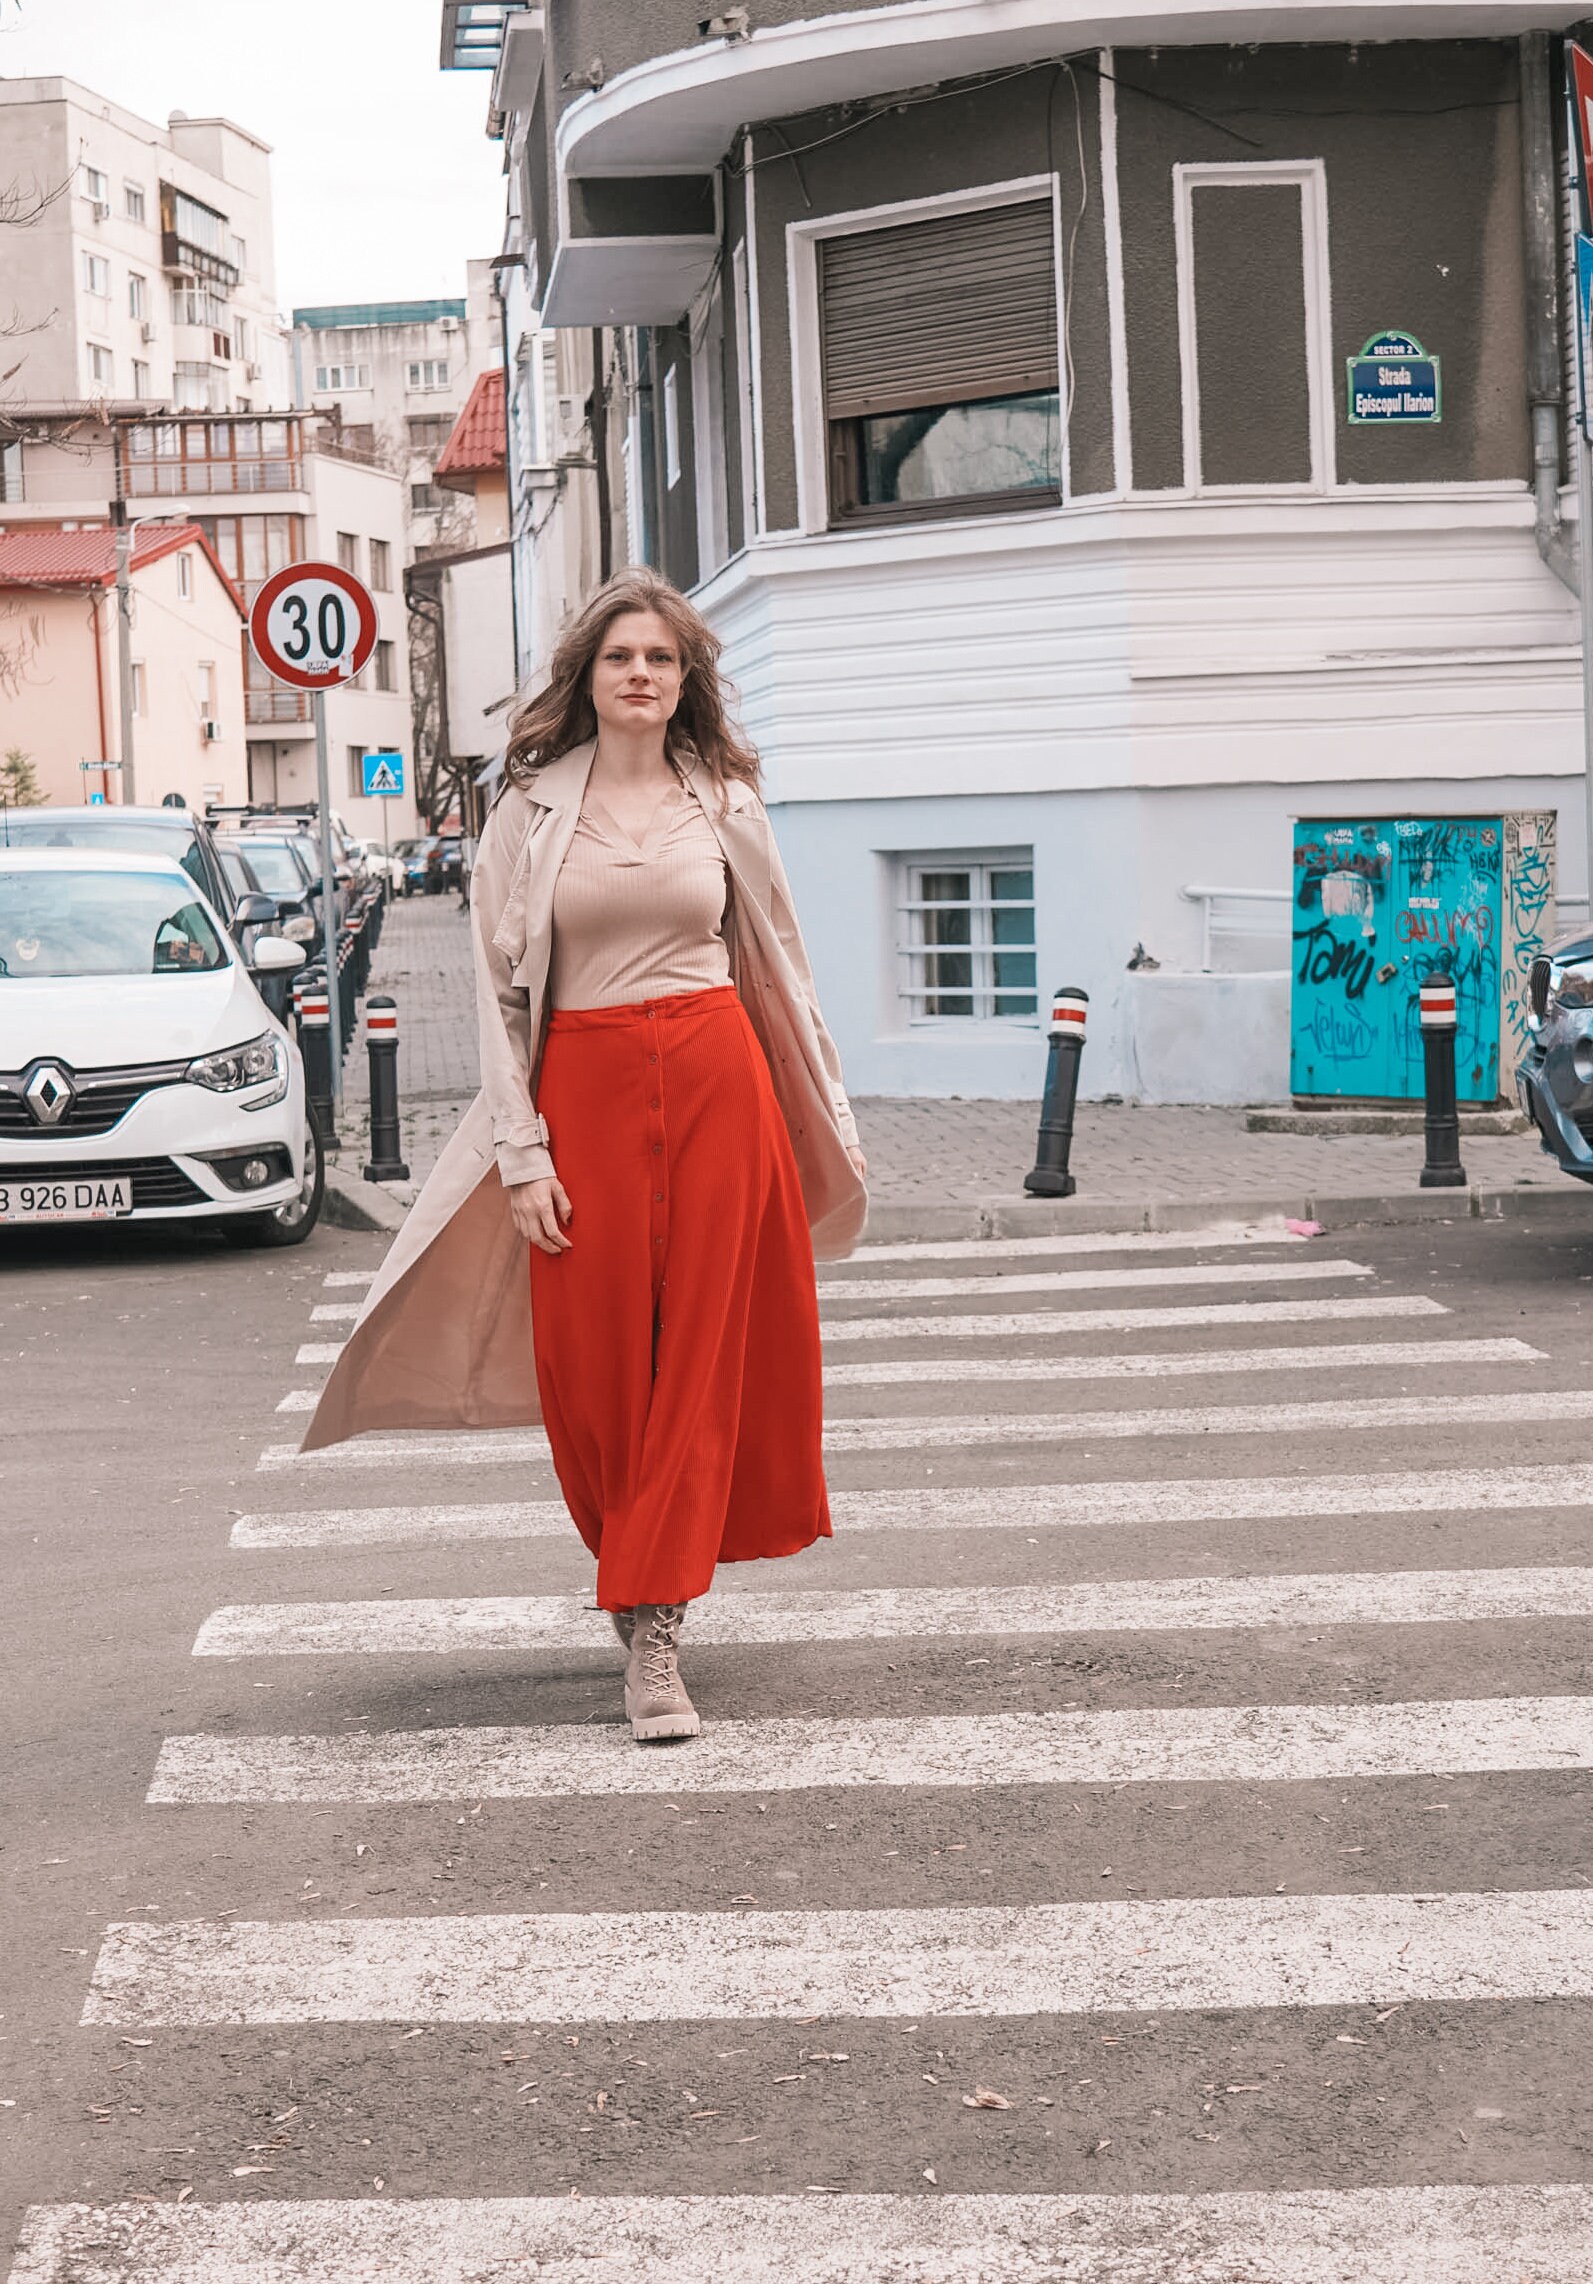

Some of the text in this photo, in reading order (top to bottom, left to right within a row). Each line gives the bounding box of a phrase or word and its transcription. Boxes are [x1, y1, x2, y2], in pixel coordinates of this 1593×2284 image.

[1373, 345, 1413, 355] SECTOR 2
[1378, 366, 1412, 386] Strada
[1355, 392, 1434, 417] Episcopul Ilarion
[282, 593, 346, 660] 30
[20, 1186, 67, 1211] 926
[75, 1183, 124, 1209] DAA
